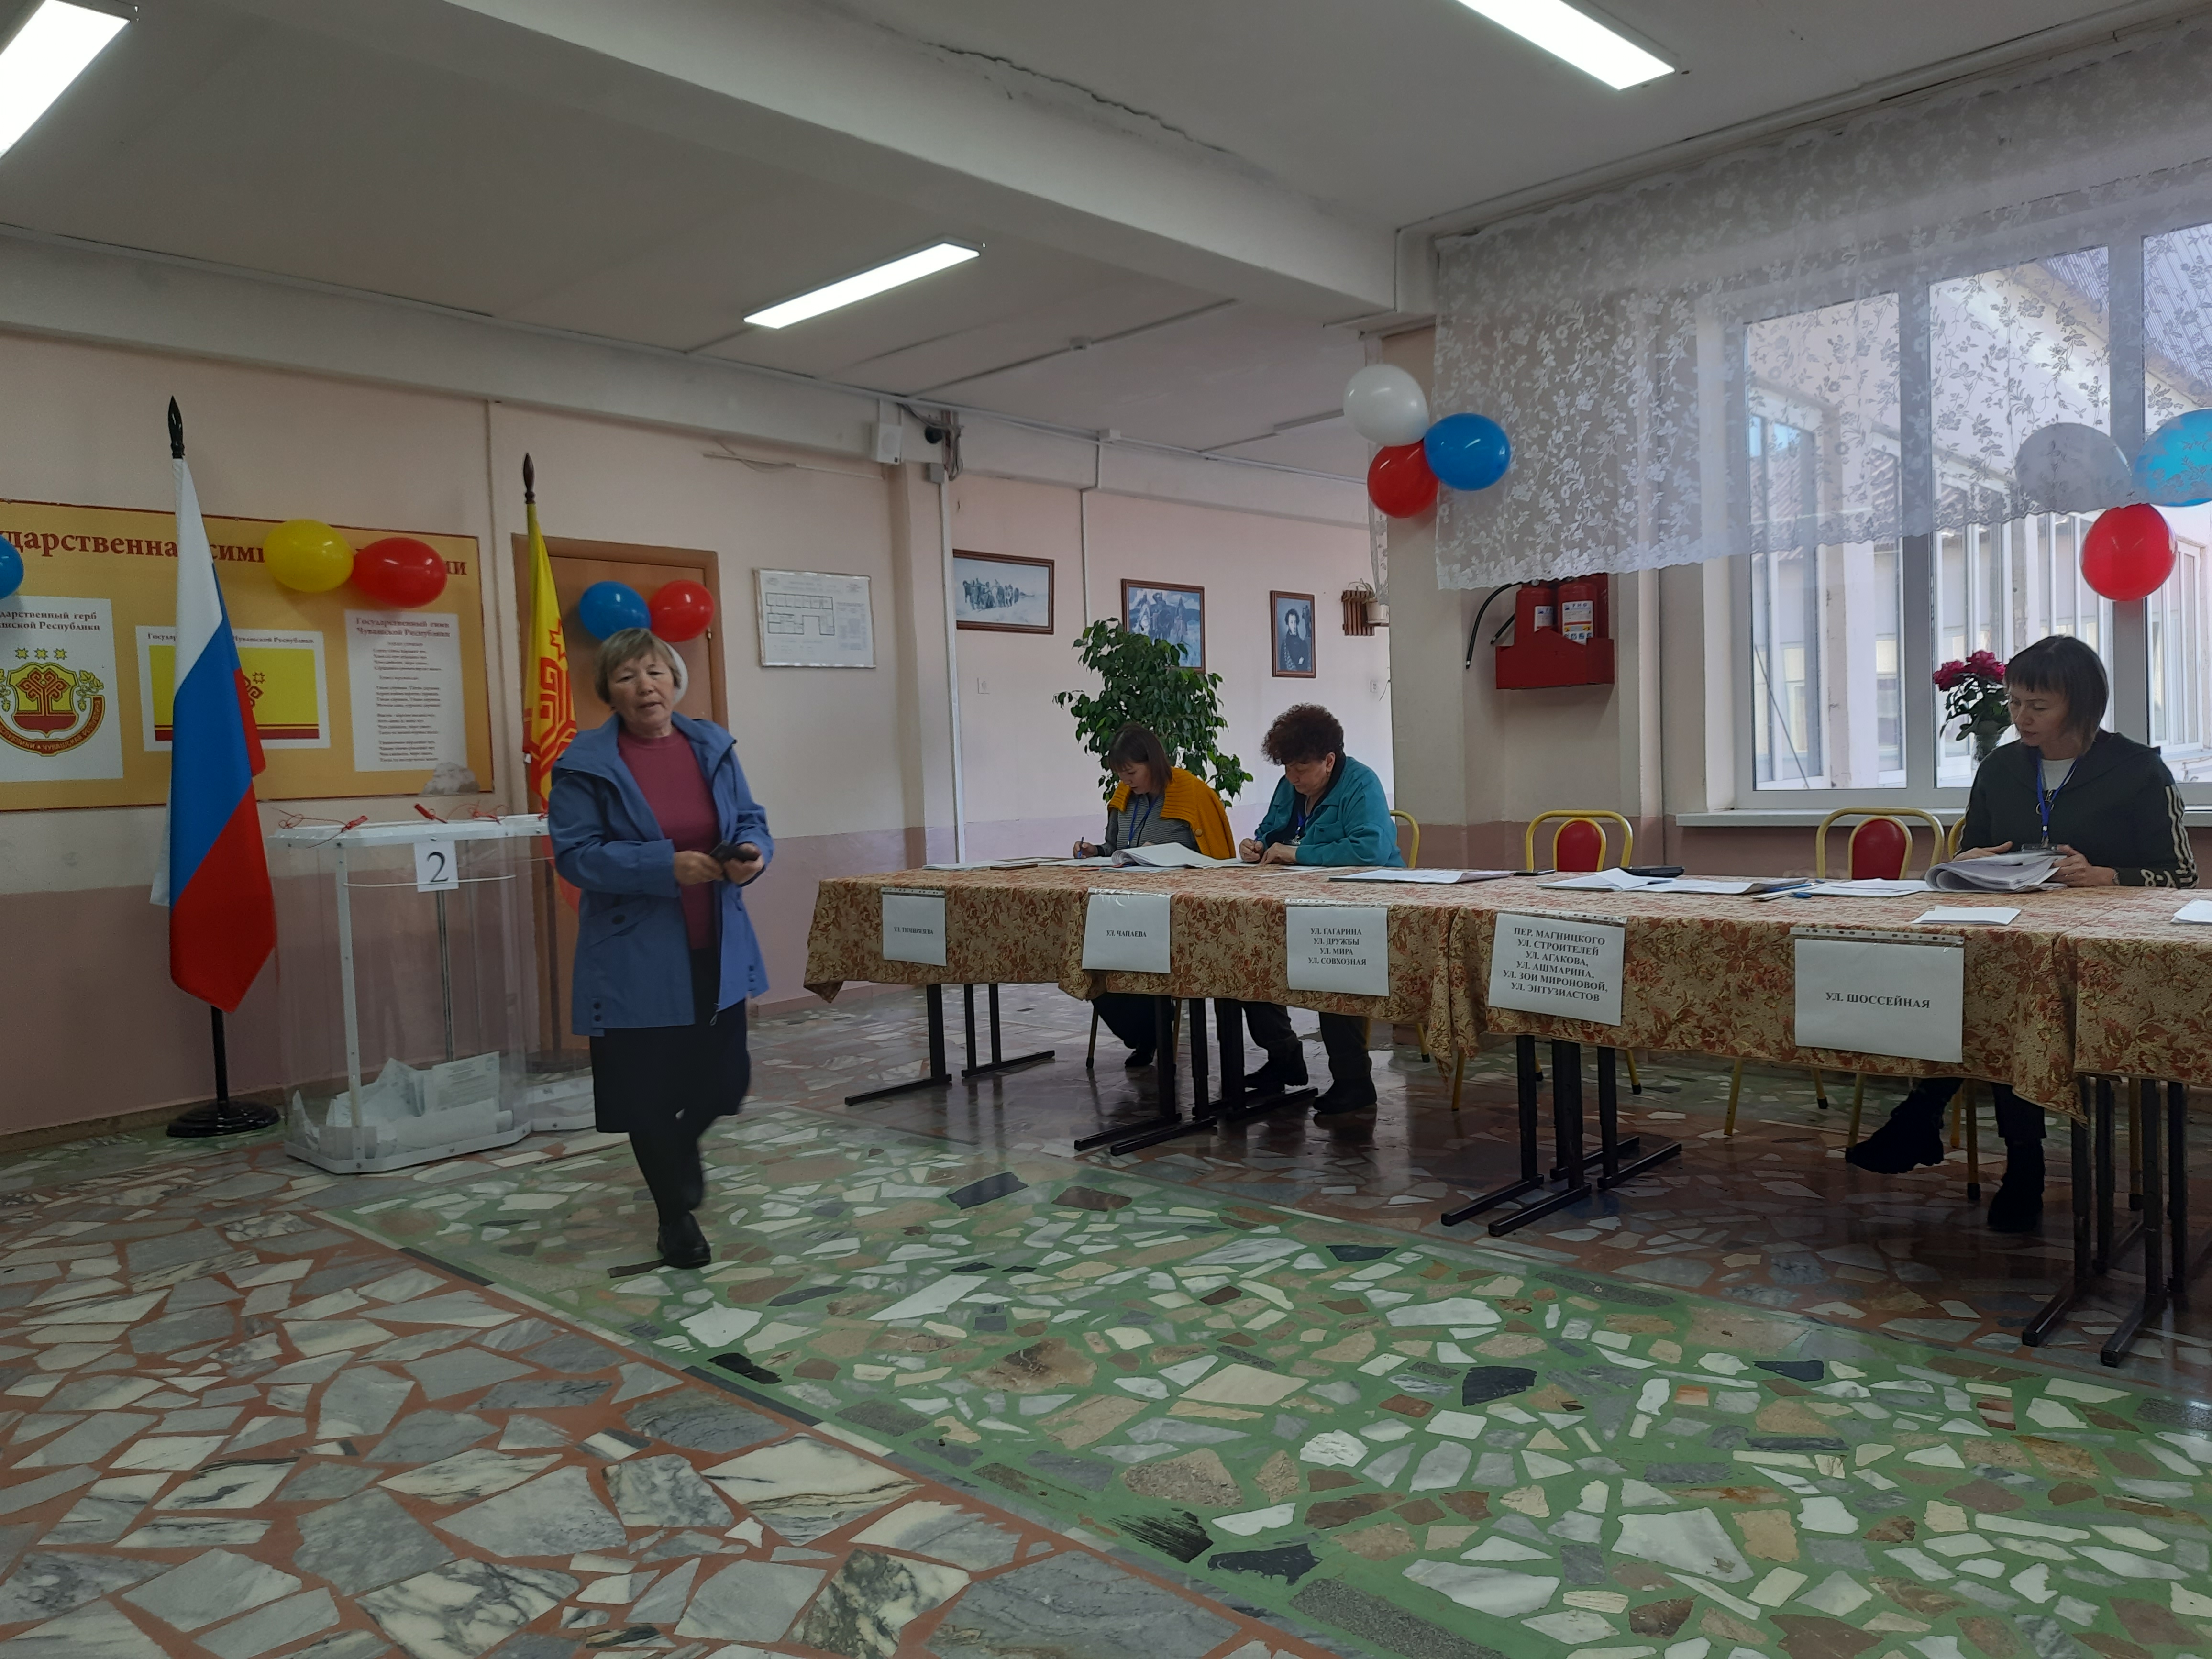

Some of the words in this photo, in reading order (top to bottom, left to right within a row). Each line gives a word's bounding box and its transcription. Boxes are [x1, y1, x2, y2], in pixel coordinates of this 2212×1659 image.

[0, 530, 178, 558] дарственна
[74, 611, 97, 621] герб
[39, 621, 100, 632] Республики
[427, 852, 449, 883] 2
[1514, 927, 1533, 937] ПЕР.
[1536, 930, 1605, 945] МАГНИЦКОГО
[1518, 939, 1531, 948] УЛ.
[1534, 940, 1599, 956] СТРОИТЕЛЕЙ
[1320, 958, 1367, 966] СОВХОЗНАЯ
[1526, 951, 1539, 960] УЛ.
[1542, 954, 1589, 968] АГАКОВА,
[1516, 961, 1530, 970] УЛ.
[1532, 963, 1594, 980] АШМАРИНА,
[1503, 970, 1516, 979] УЛ.
[1519, 972, 1537, 982] ЗОИ
[1540, 975, 1608, 992] МИРОНОВОЙ,
[1511, 982, 1525, 991] УЛ.
[1527, 984, 1600, 1001] ЭНТУЗИАСТОВ
[1825, 992, 1844, 1002] УЛ.
[1847, 994, 1930, 1009] ШОССЕЙНАЯ
